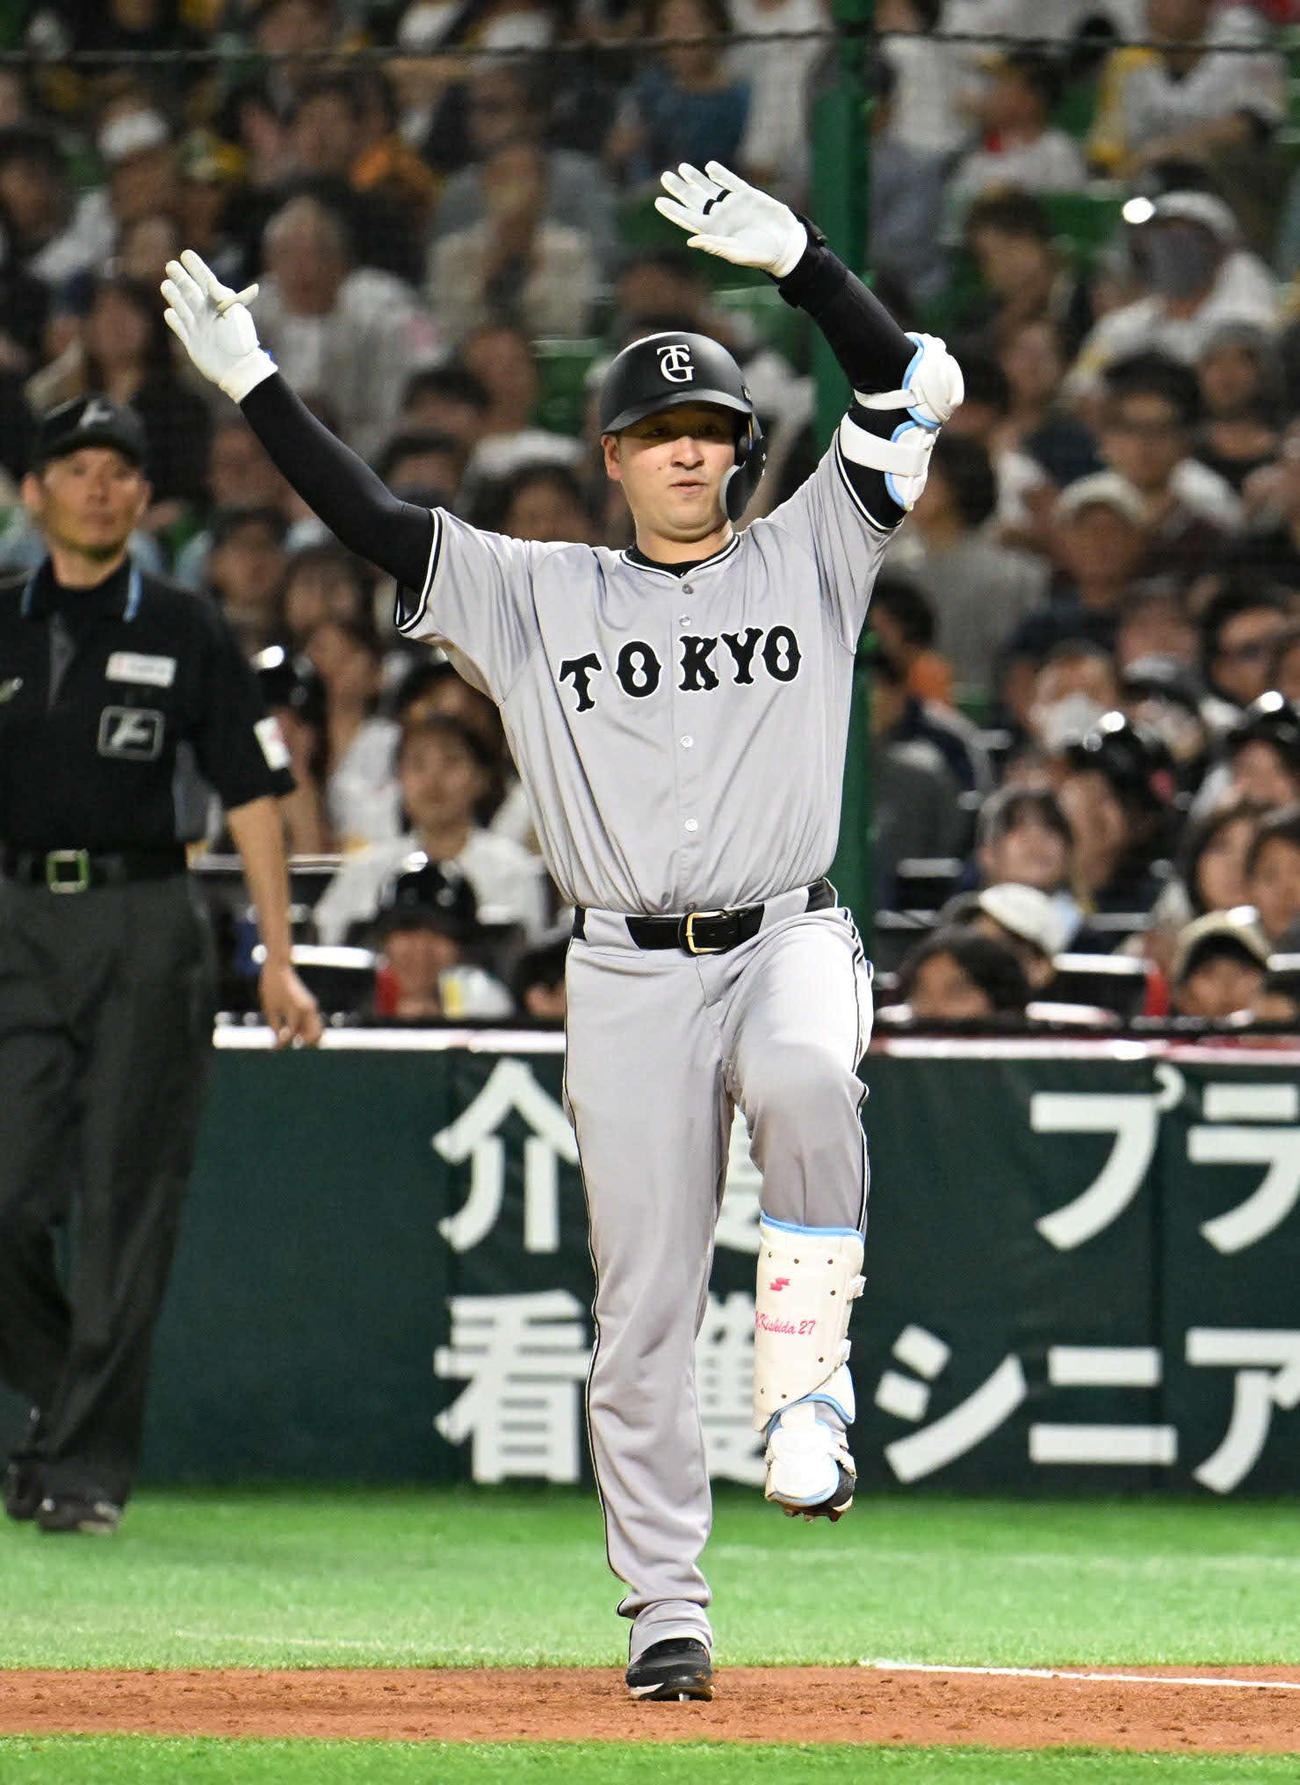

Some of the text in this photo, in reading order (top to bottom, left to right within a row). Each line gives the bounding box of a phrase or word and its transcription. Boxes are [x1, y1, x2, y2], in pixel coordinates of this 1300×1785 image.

[557, 624, 802, 714] TOKYO
[798, 1320, 816, 1335] 27
[874, 1324, 1300, 1495] シニア
